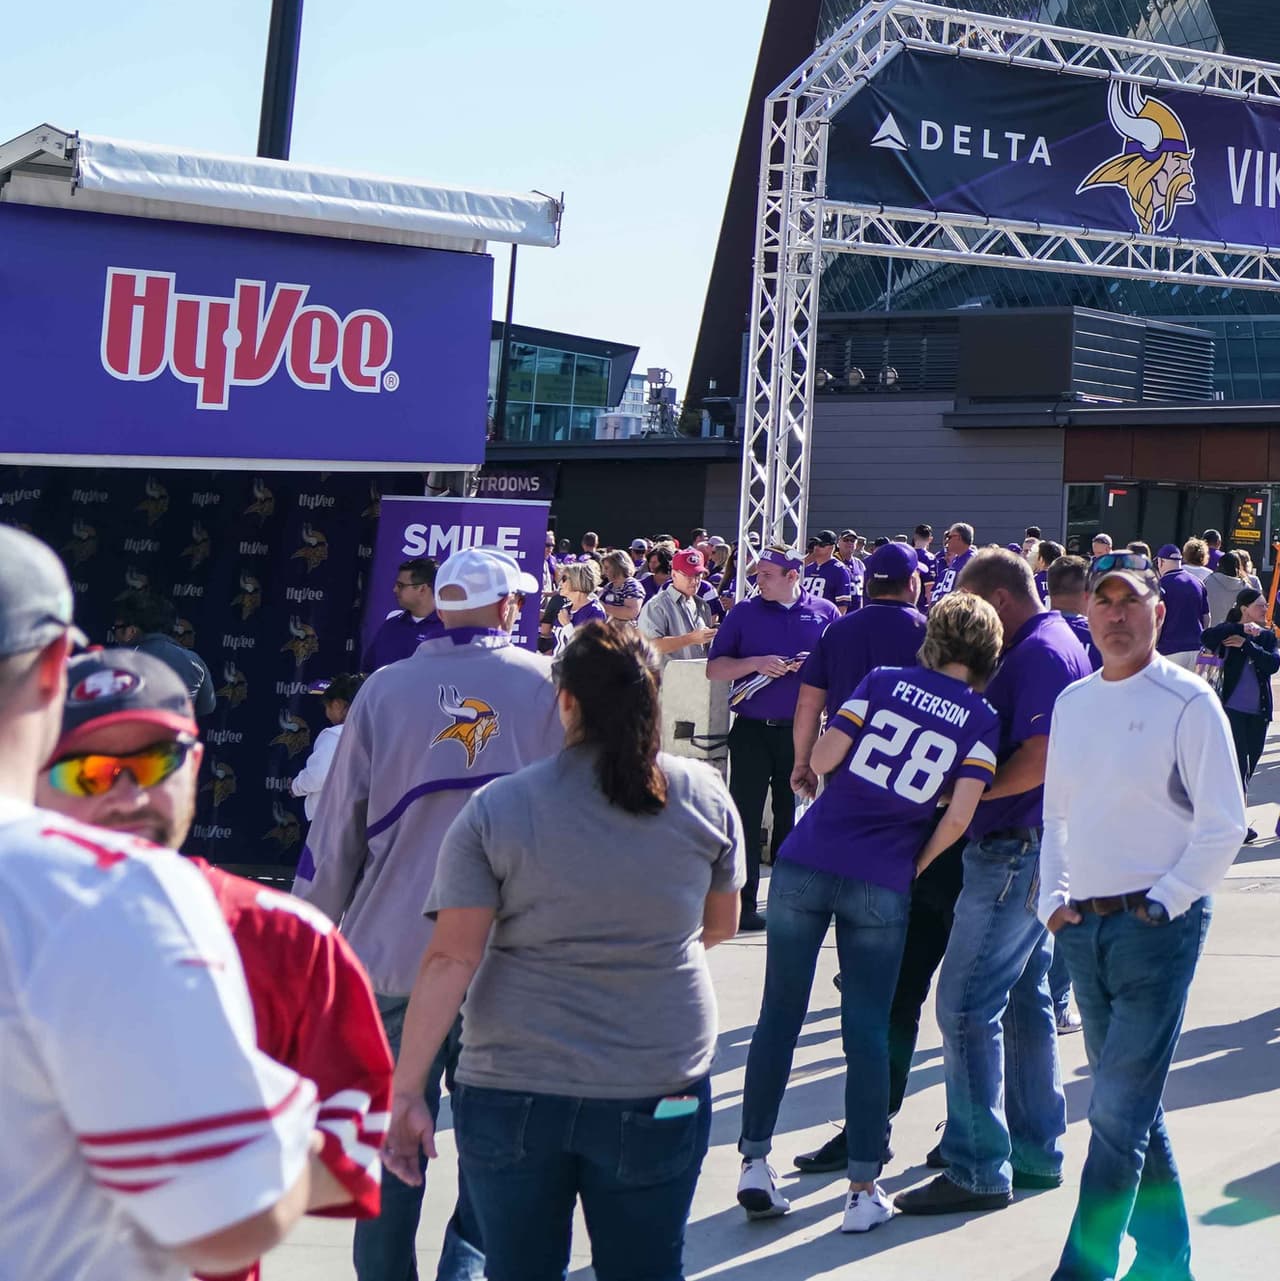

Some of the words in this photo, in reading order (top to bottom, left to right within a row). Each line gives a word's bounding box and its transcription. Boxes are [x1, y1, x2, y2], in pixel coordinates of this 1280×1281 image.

[919, 119, 1052, 166] DELTA
[480, 476, 540, 492] TROOMS
[299, 493, 336, 510] HyVee
[286, 587, 324, 603] HyVee
[891, 680, 970, 728] PETERSON
[206, 729, 243, 745] HyVee
[849, 709, 958, 805] 28
